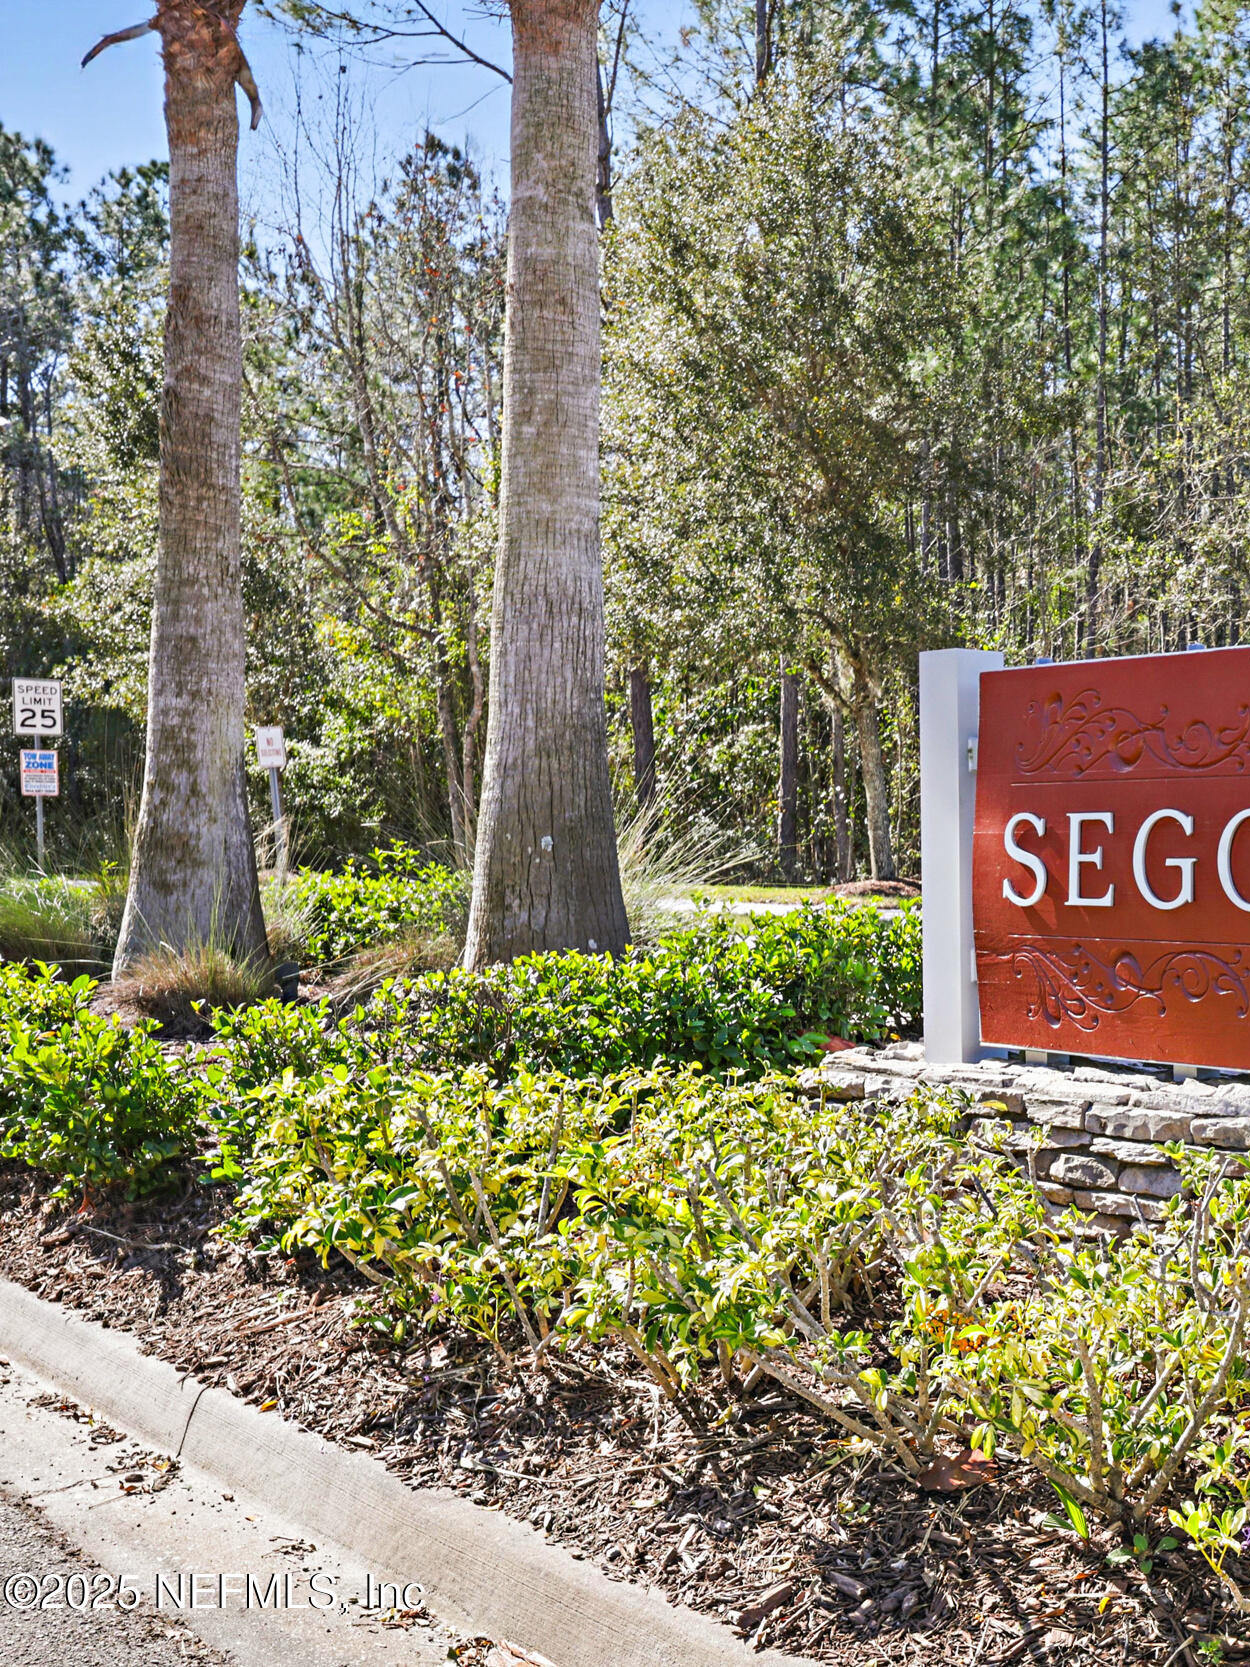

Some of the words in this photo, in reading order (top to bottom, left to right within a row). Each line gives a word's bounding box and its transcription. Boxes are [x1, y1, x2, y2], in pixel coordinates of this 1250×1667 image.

[18, 685, 57, 695] SPEED
[22, 697, 52, 706] LIMIT
[20, 708, 57, 728] 25
[24, 752, 37, 760] TOW
[25, 761, 54, 769] ZONE
